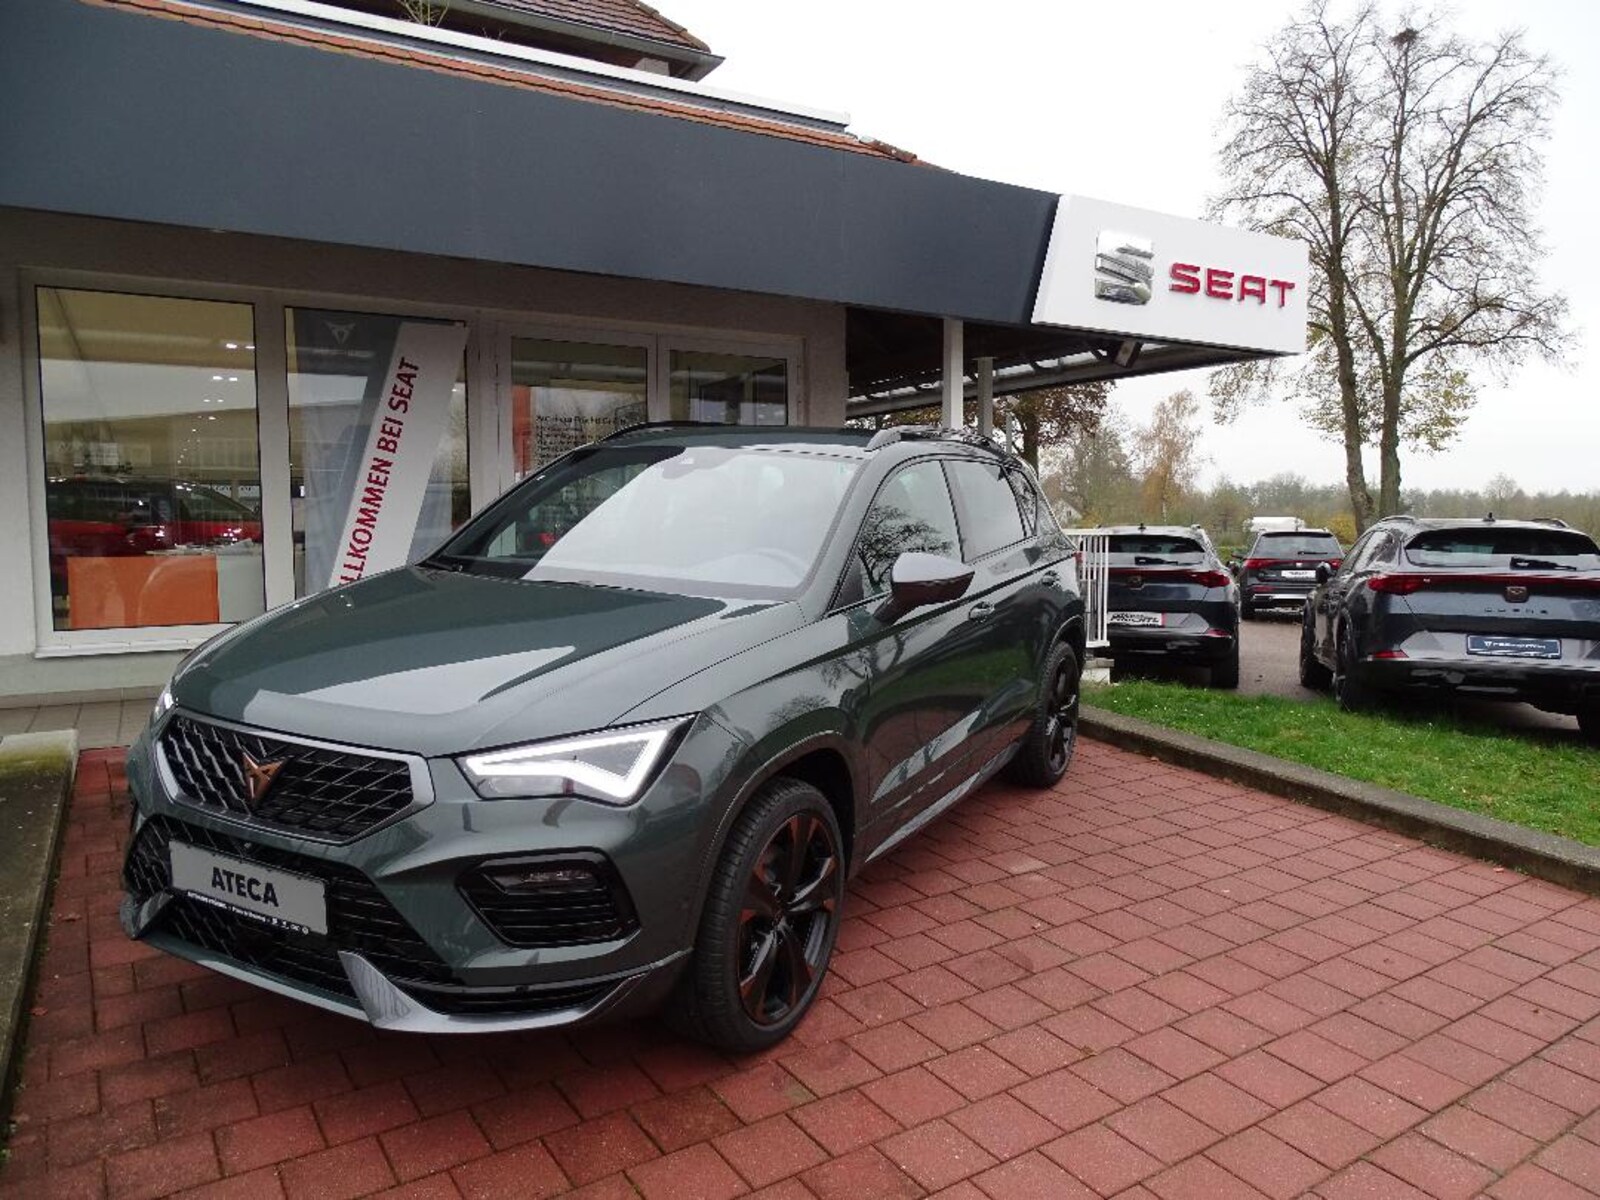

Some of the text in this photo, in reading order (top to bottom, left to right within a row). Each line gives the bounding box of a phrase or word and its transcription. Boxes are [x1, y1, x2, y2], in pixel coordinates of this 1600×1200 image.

[1169, 262, 1296, 309] SEAT
[340, 357, 419, 583] LLKOMMEN BEI SEAT
[211, 866, 279, 908] ATECA
